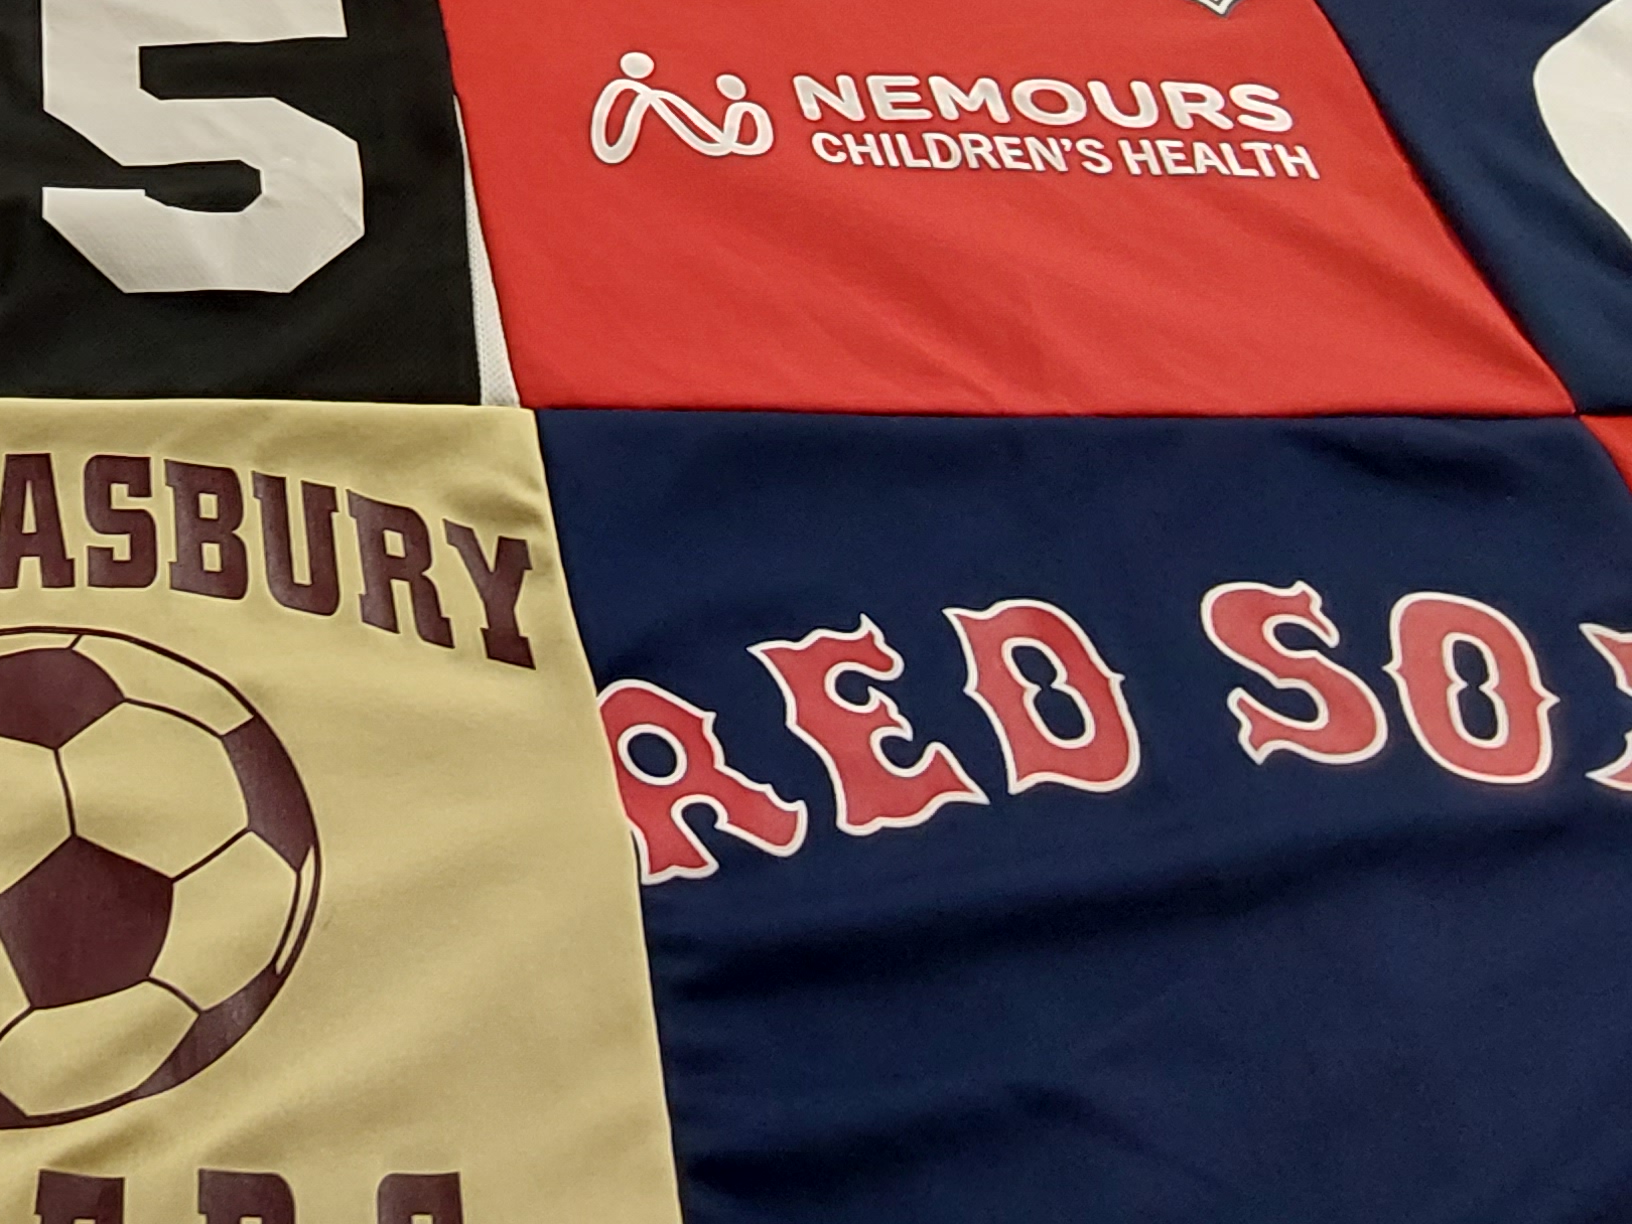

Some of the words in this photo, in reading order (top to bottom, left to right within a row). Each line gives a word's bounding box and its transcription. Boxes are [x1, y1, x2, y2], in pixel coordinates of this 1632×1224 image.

[793, 73, 1295, 133] NEMOURS
[811, 131, 1111, 176] CHILDREN'S
[1119, 139, 1321, 181] HEALTH
[596, 598, 1142, 885] RED
[1200, 580, 1632, 791] SO
